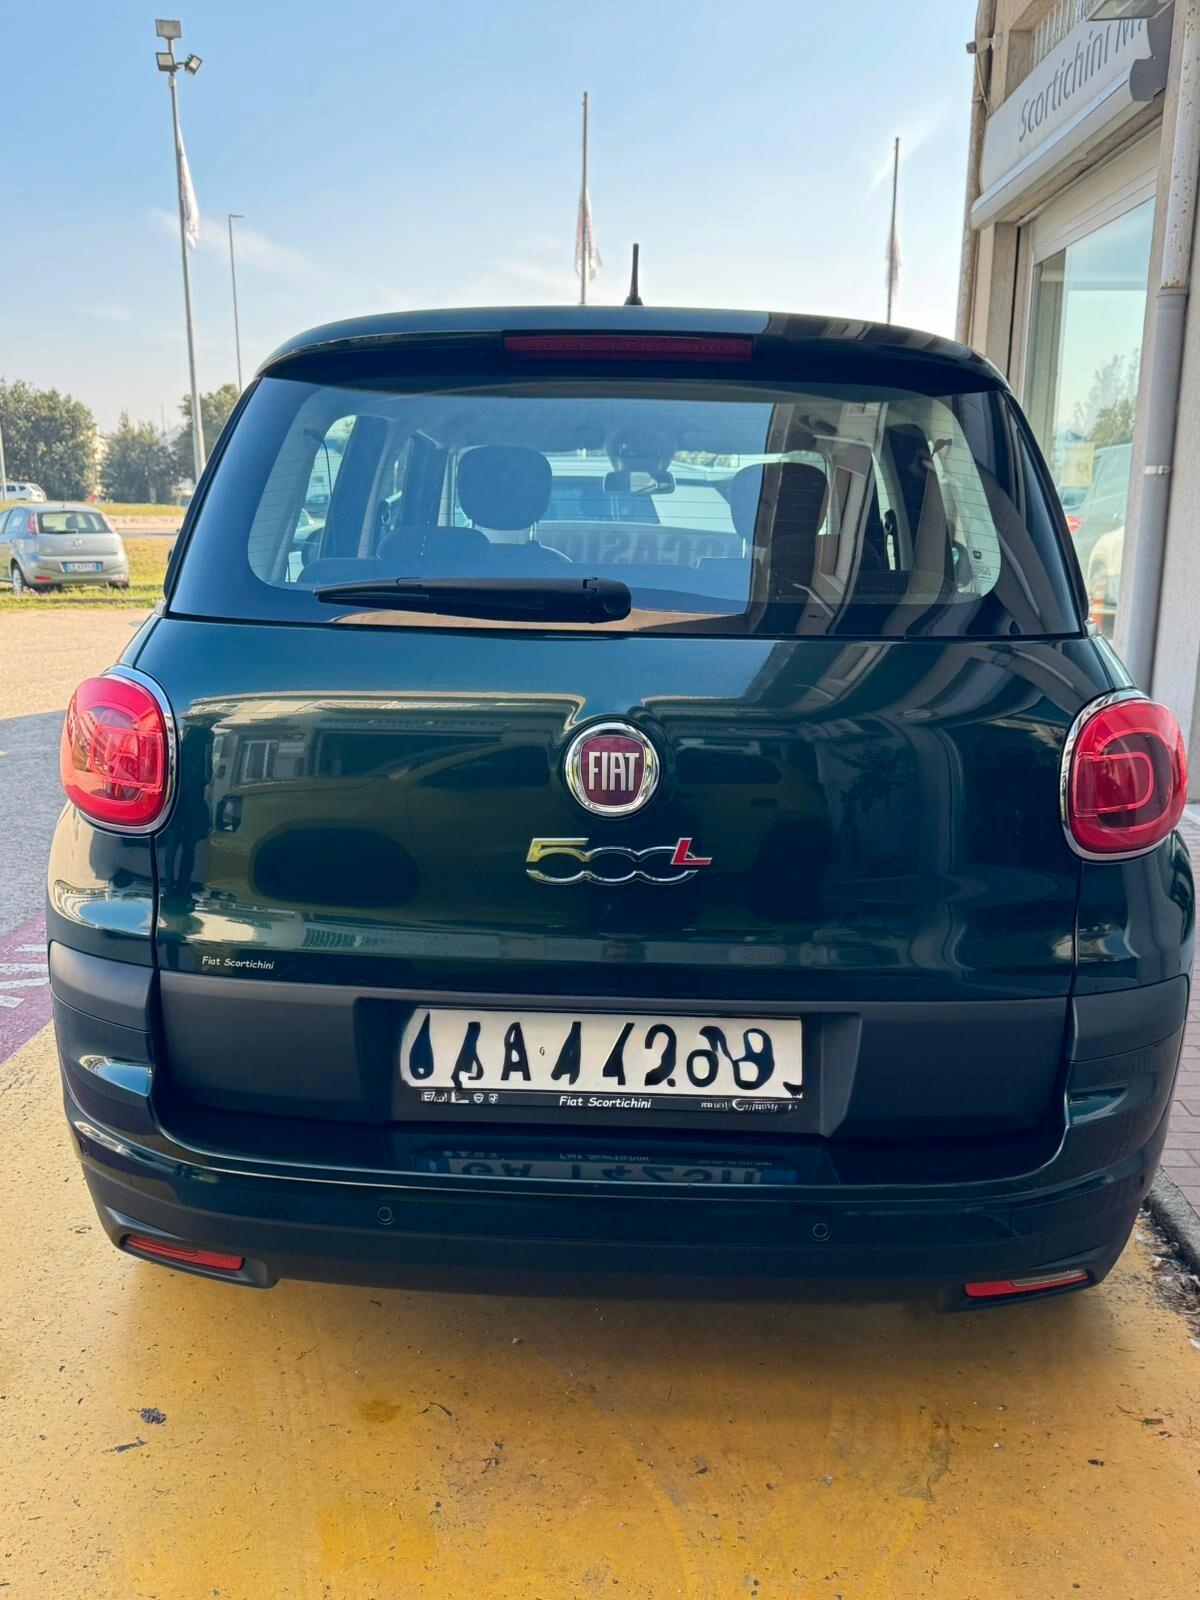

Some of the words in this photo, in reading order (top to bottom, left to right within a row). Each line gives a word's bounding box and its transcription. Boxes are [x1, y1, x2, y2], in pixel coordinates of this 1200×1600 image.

[1019, 25, 1110, 142] Scortichini
[1115, 19, 1143, 54] M
[588, 751, 640, 792] FIAT
[525, 837, 713, 886] 500L
[202, 956, 221, 966] Fiat
[224, 959, 275, 970] Scortichini
[559, 1095, 583, 1107] Fiat
[587, 1097, 652, 1109] Scortichini
